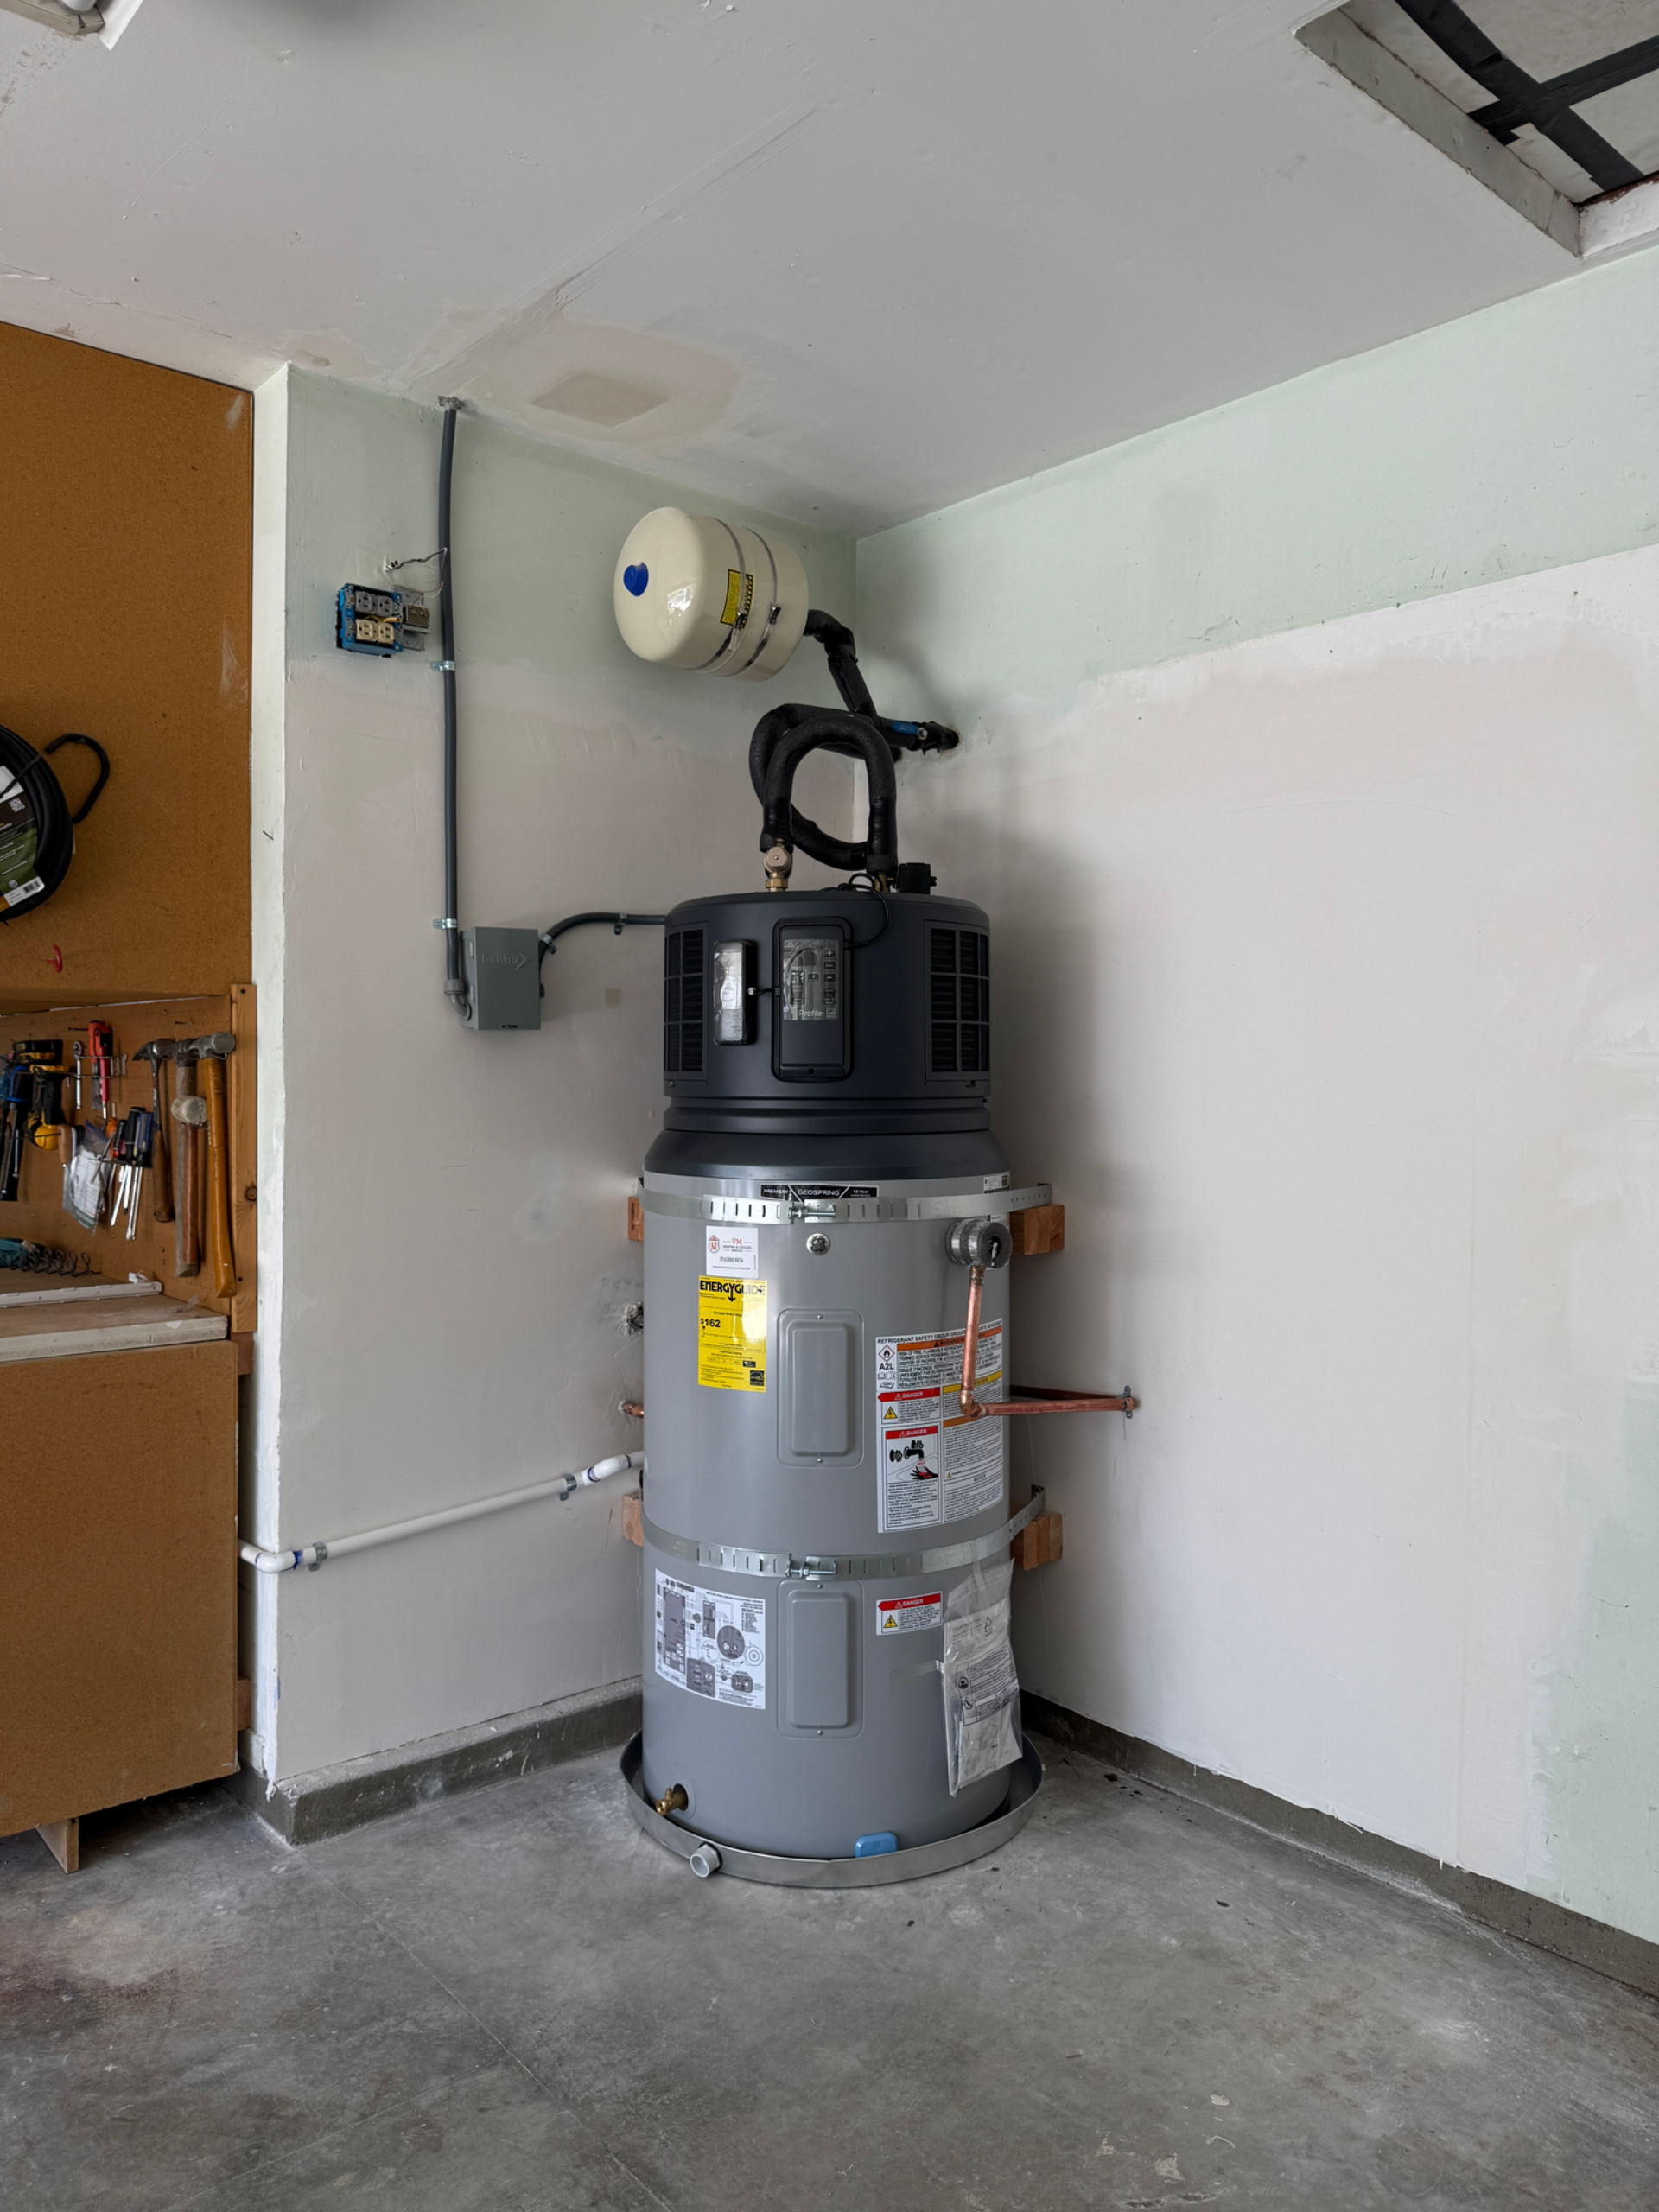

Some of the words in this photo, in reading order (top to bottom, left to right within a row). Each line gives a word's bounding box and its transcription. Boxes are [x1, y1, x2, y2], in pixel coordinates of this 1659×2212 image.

[798, 1188, 840, 1197] GEOSPRING
[700, 1281, 766, 1295] ENERGYGUIDE
[700, 1318, 721, 1328] $162
